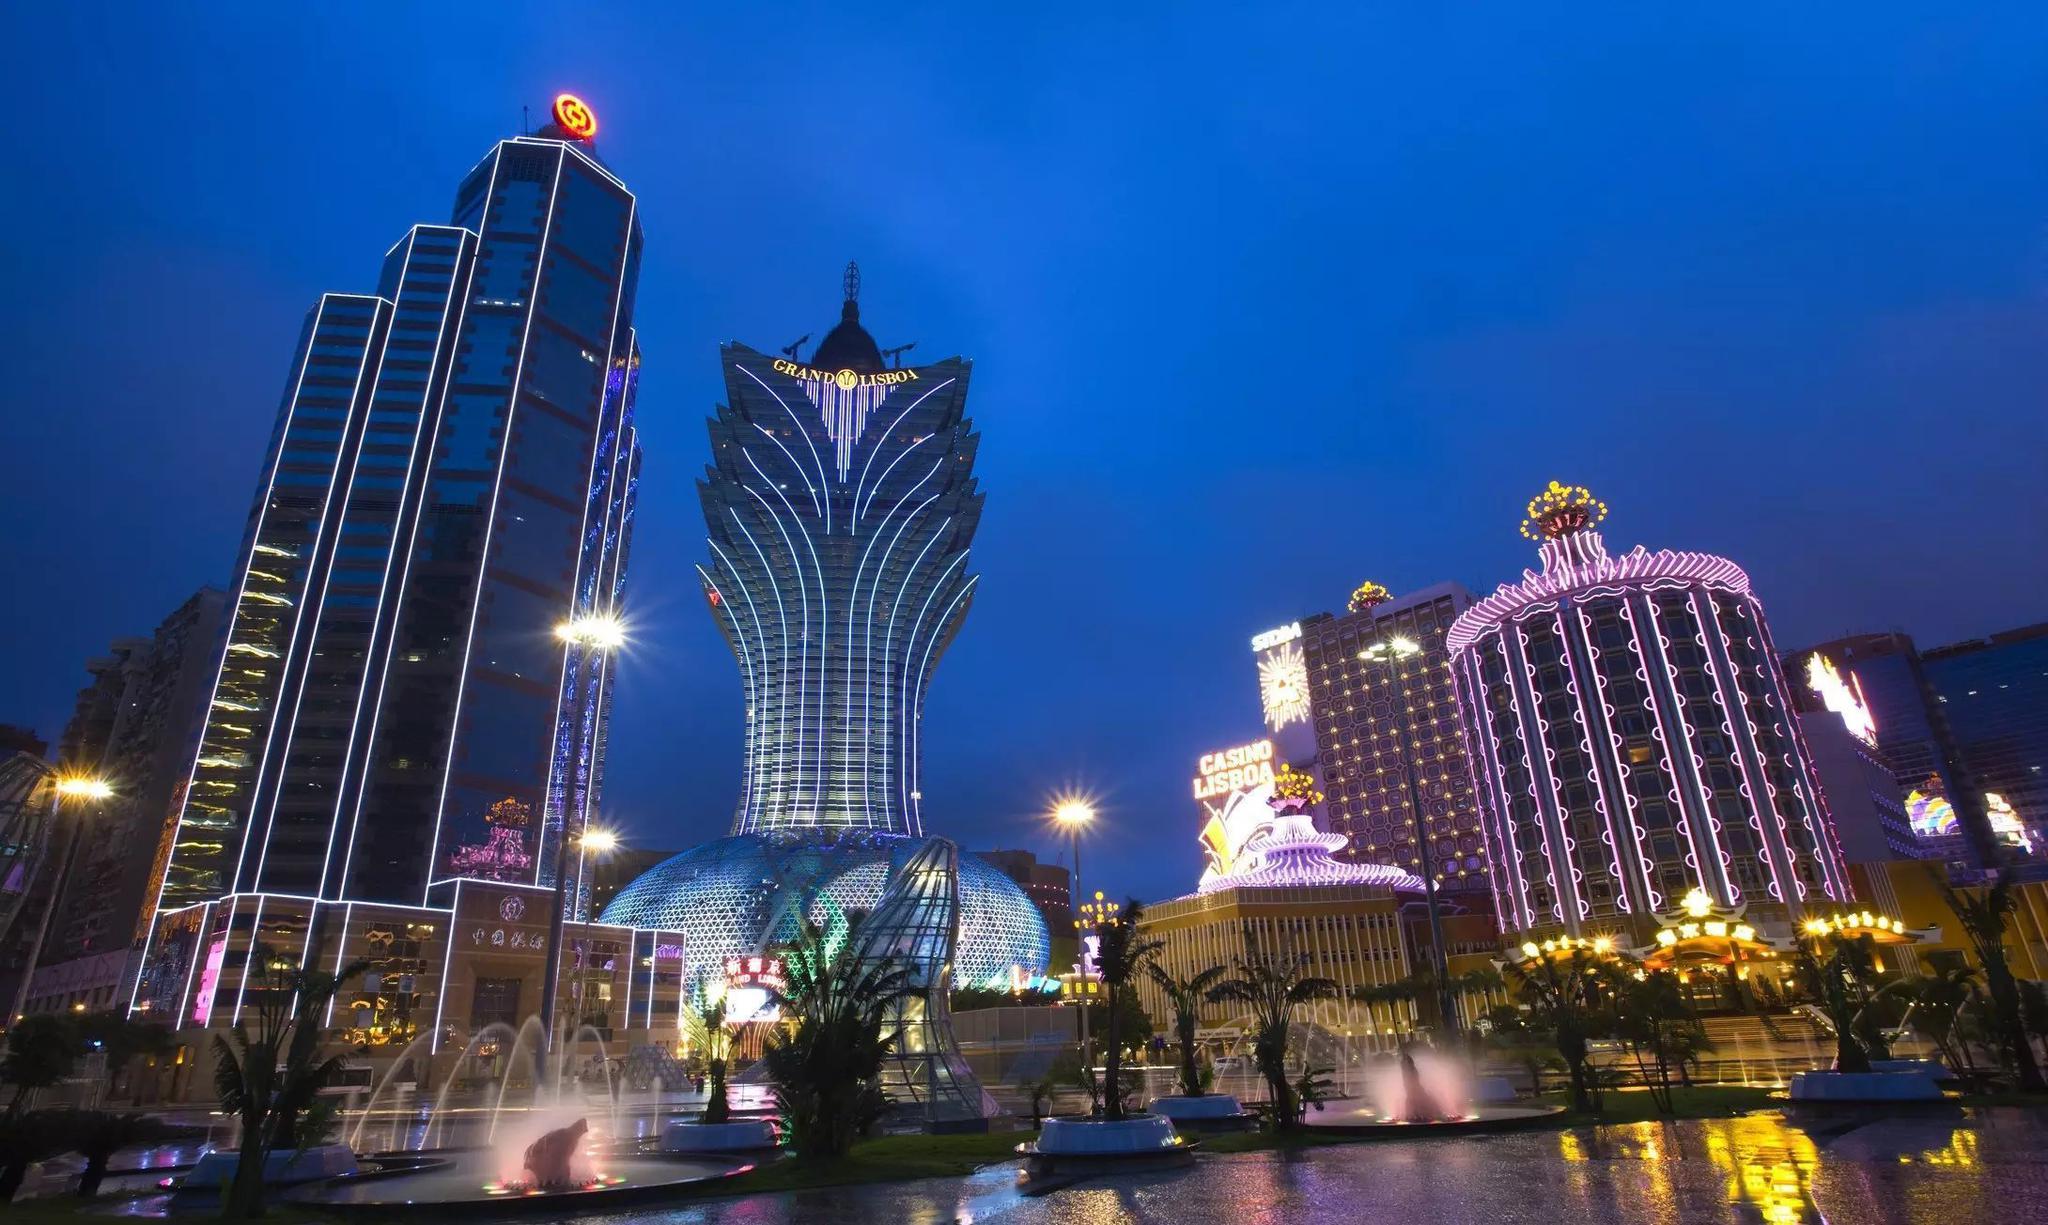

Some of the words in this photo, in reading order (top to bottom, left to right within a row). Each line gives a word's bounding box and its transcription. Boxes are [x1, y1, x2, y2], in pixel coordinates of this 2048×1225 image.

[773, 359, 835, 385] GRAND
[860, 369, 919, 386] LISBOA
[1199, 740, 1273, 775] CASINO
[1193, 761, 1275, 799] LISBOA
